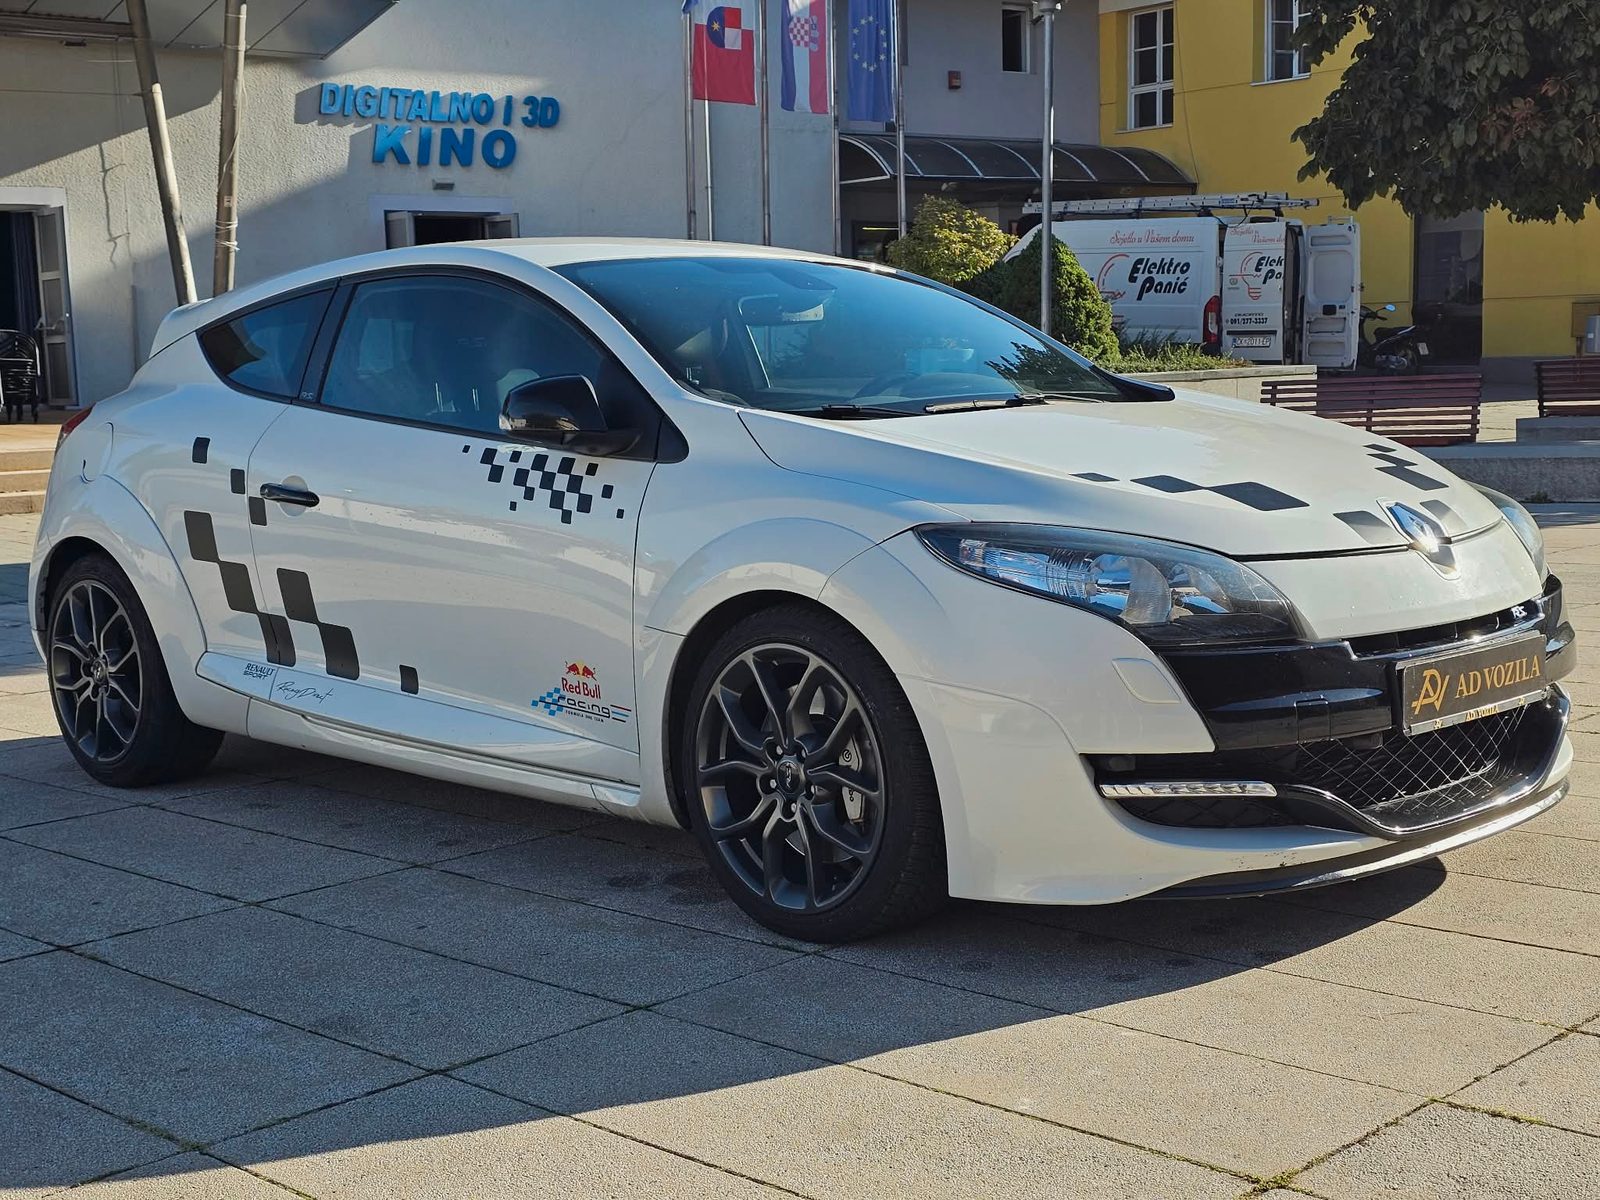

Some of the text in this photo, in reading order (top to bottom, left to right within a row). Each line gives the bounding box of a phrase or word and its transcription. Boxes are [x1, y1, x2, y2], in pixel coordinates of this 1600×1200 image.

[320, 82, 560, 128] DIGITALNO I 3D
[372, 123, 517, 169] KINO
[1144, 229, 1171, 244] Vašem
[1171, 230, 1195, 243] domu
[1128, 257, 1191, 283] Elektro
[1136, 276, 1189, 301] Panić
[1510, 605, 1528, 619] RS
[243, 671, 269, 680] SPORT
[244, 663, 275, 676] RENAULT
[1454, 671, 1482, 699] AD
[1483, 655, 1541, 690] VOZILA
[561, 677, 601, 700] Red Bull
[557, 695, 611, 719] racing
